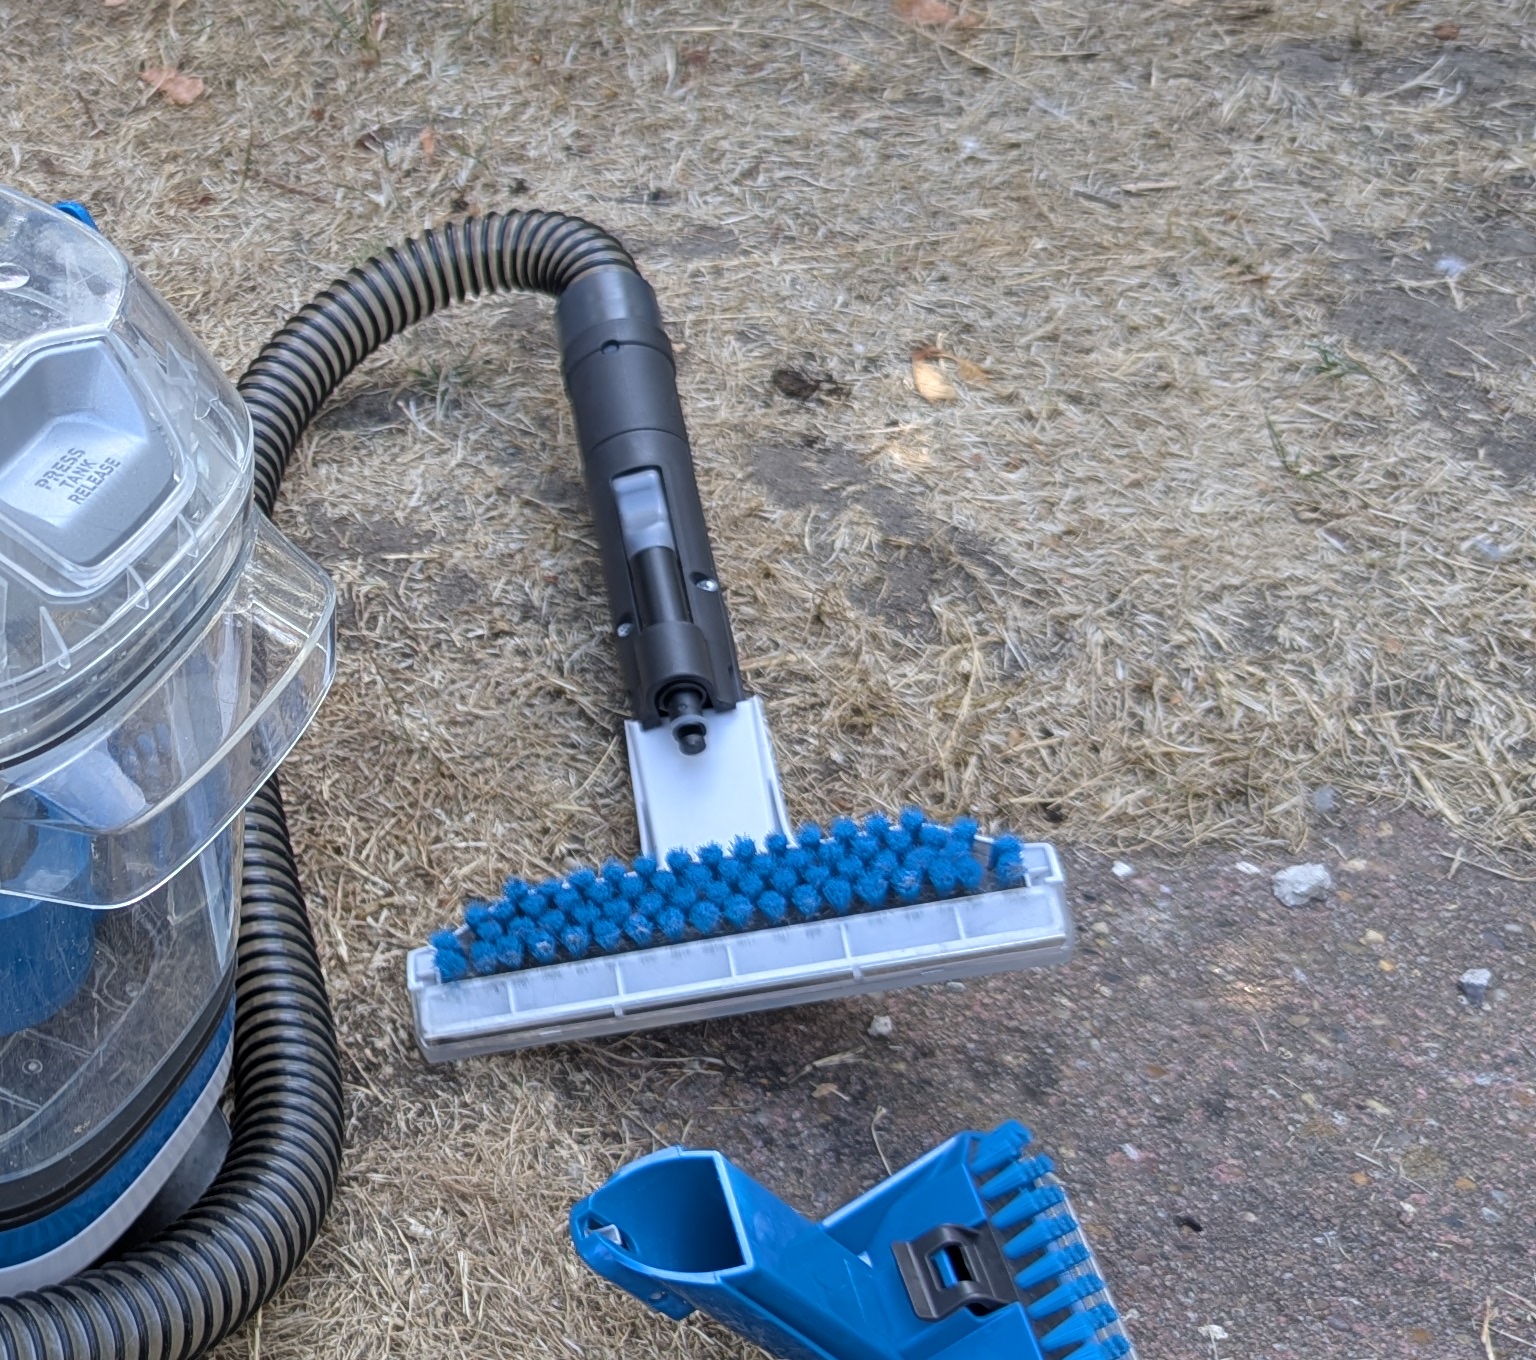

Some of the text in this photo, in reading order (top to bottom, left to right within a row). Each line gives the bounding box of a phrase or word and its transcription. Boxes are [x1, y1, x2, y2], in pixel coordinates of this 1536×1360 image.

[34, 447, 86, 490] PRESS
[58, 459, 98, 489] TANK
[67, 457, 121, 505] RELEASE
